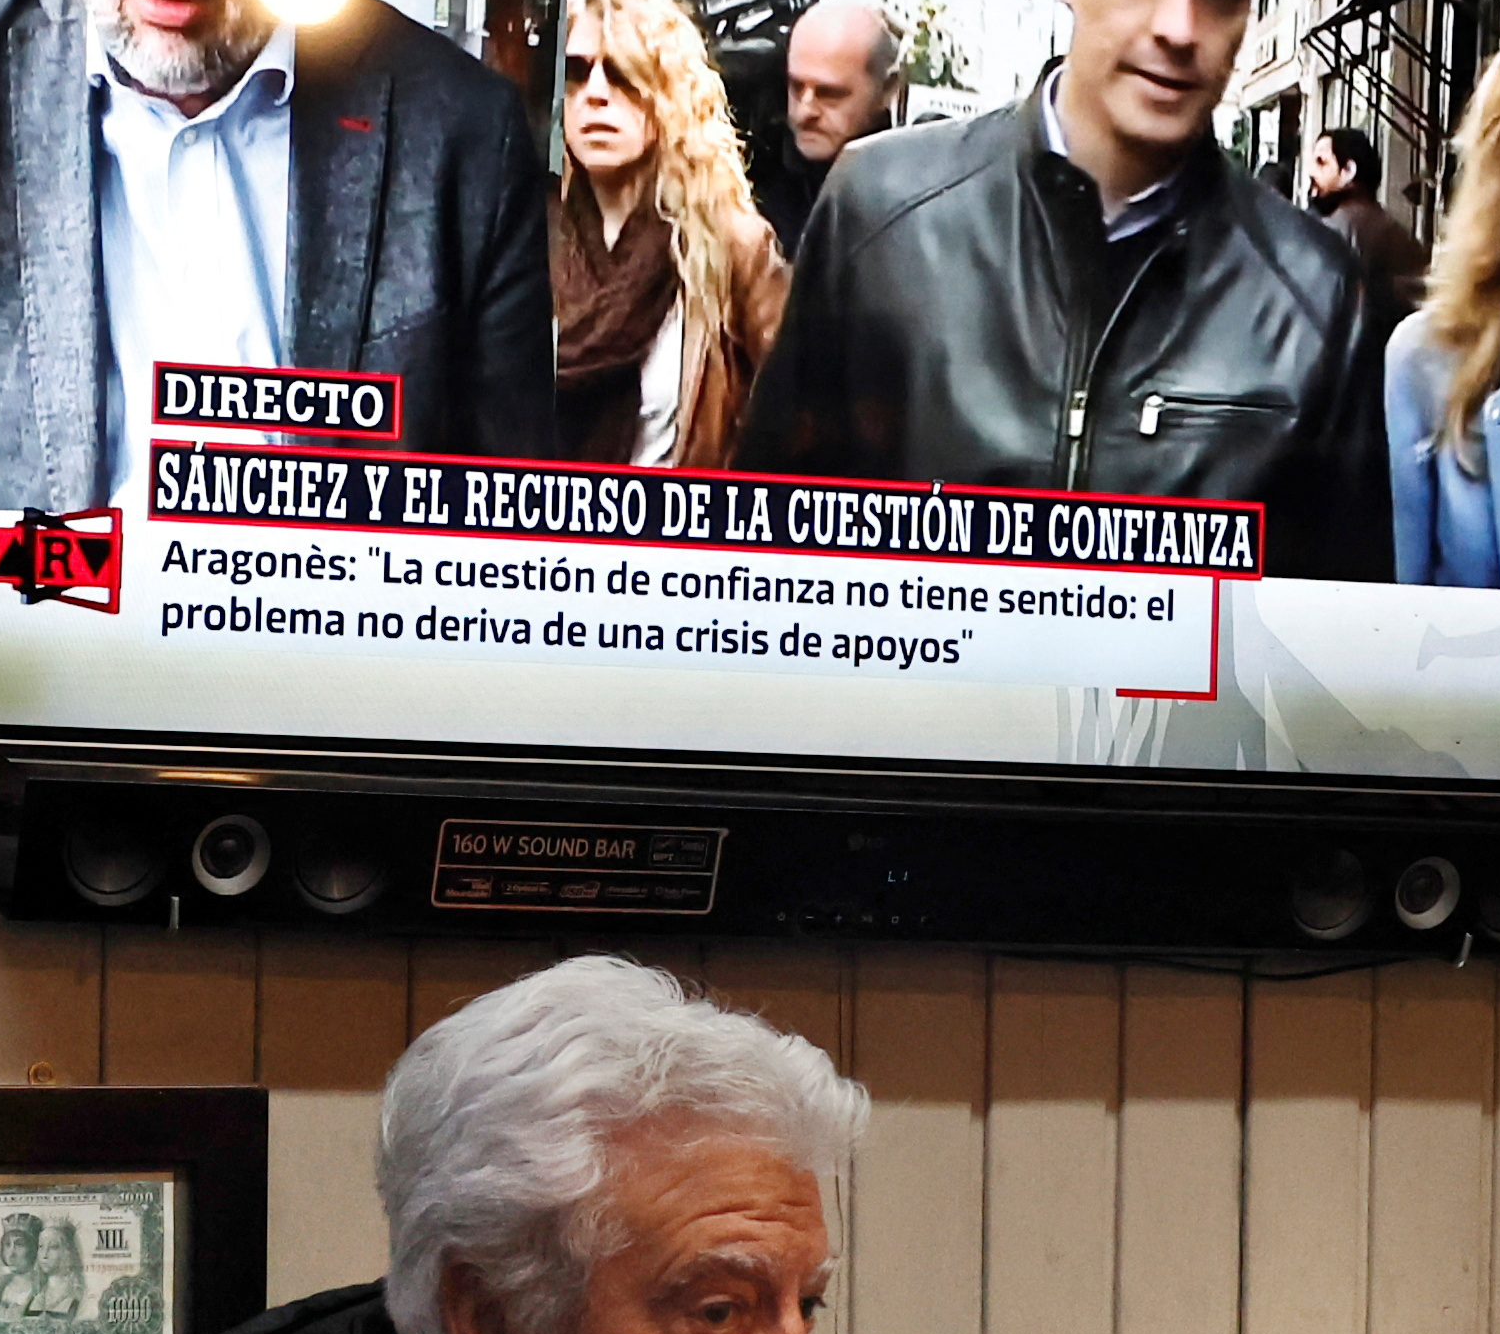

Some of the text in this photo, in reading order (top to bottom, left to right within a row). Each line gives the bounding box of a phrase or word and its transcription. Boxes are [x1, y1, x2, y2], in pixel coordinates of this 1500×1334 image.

[162, 373, 385, 428] DIRECTO
[156, 442, 1254, 568] SÁNCHEZ Y EL RECURSO DE LA CUESTIÓN DE CONFIANZA
[162, 540, 1175, 622] Aragonès: "La cuestión de confianza no tiene sentido: el
[162, 596, 974, 670] problema no deriva de una crisis de apoyos"
[453, 834, 486, 854] 160
[493, 835, 515, 855] W
[517, 836, 589, 858] SOUND
[595, 839, 635, 859] BAR
[96, 1229, 128, 1250] MIL
[107, 1296, 151, 1323] 1000
